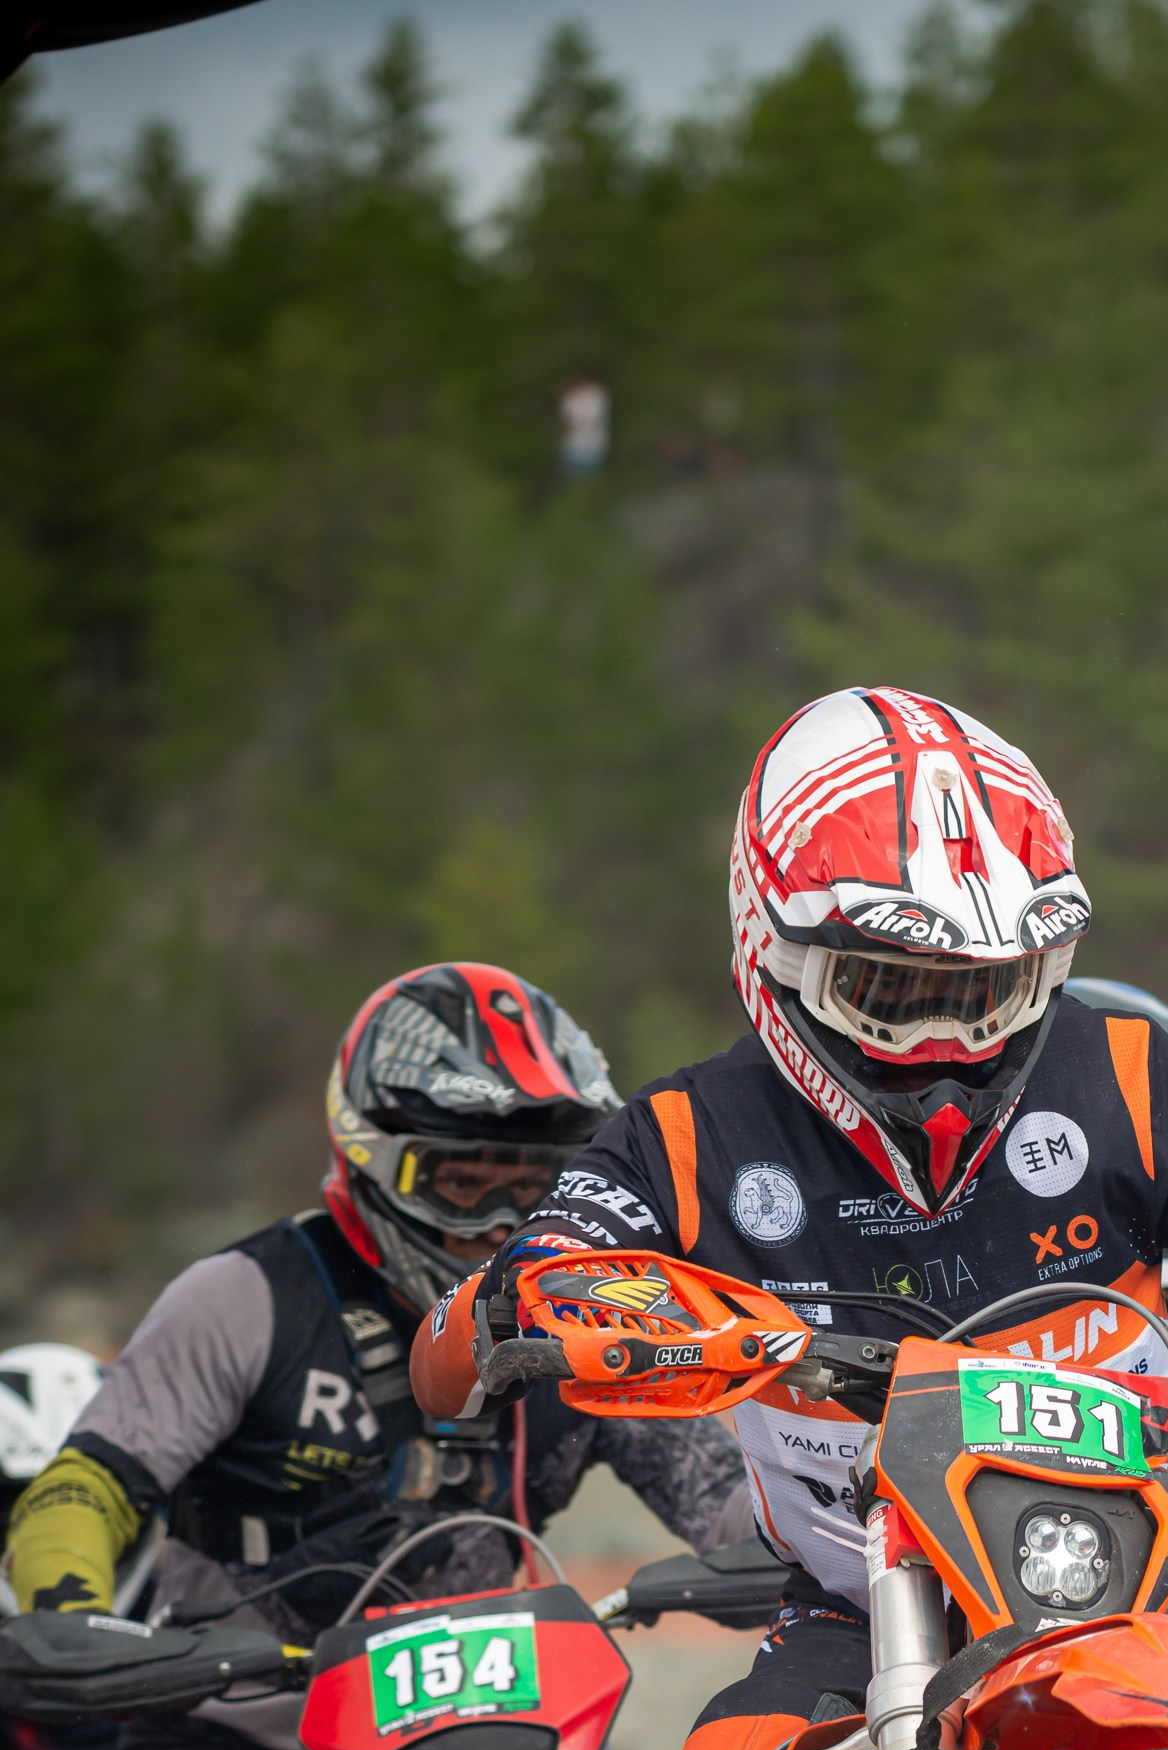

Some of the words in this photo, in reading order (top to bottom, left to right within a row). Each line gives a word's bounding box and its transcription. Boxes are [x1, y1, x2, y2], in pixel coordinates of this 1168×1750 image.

[854, 902, 953, 950] Airoh
[1026, 897, 1090, 949] Airoh
[860, 1210, 963, 1236] КВАДРОЦЕНТР
[1038, 1260, 1068, 1281] EXTRA
[1069, 1247, 1103, 1273] OPTIONS
[984, 1381, 1124, 1460] 151
[779, 1432, 831, 1456] YAMI
[969, 1444, 1001, 1453] УРАЛ
[1014, 1444, 1060, 1454] АСБЕСТ
[384, 1636, 518, 1708] 154
